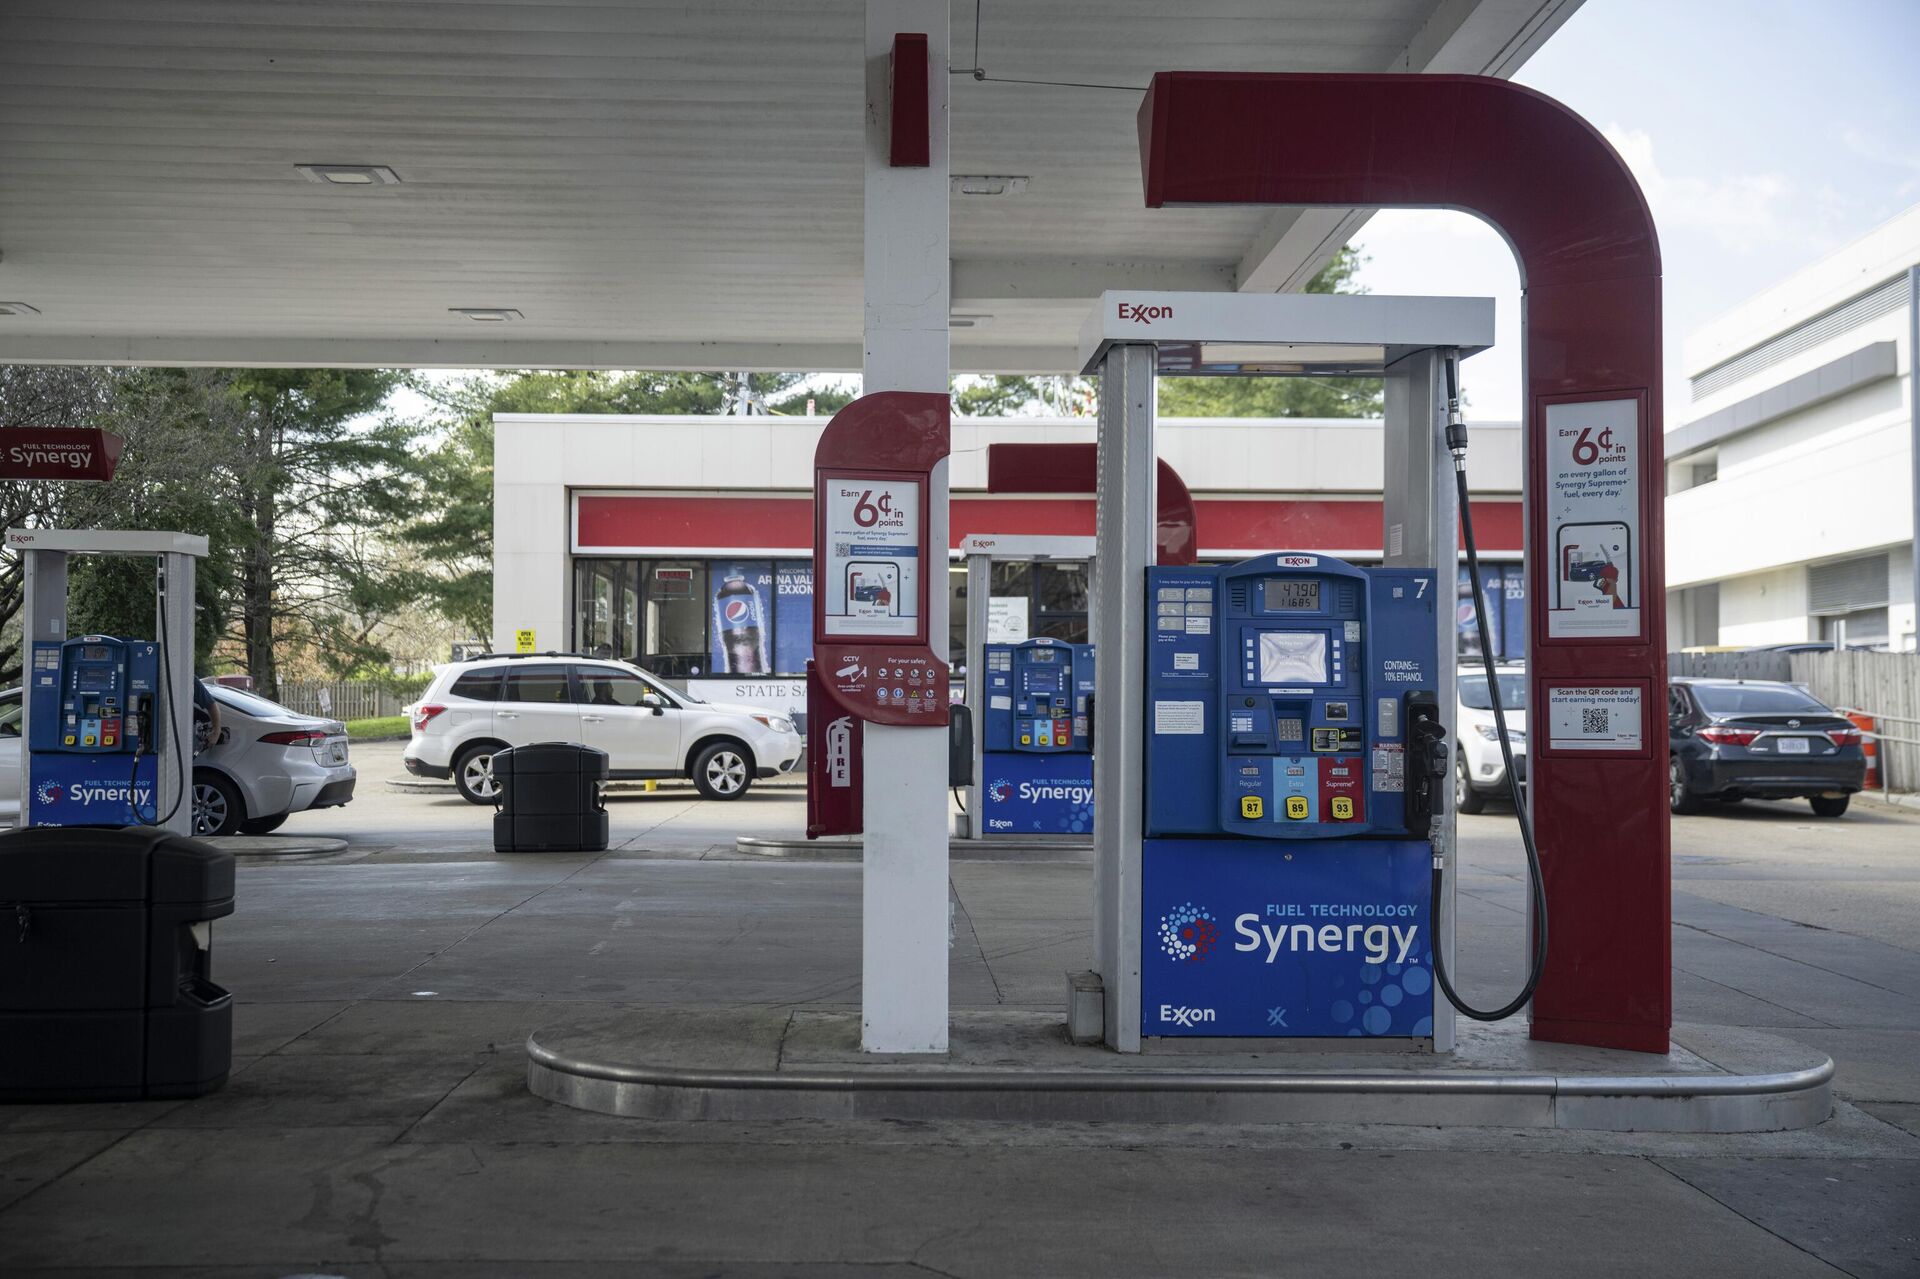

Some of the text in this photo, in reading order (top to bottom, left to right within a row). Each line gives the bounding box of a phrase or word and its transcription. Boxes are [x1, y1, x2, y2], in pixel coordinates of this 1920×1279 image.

[1118, 303, 1172, 324] Exxon
[1559, 426, 1626, 466] Earn 6¢ in
[10, 447, 92, 468] Synergy
[1598, 455, 1626, 465] points
[1570, 471, 1592, 479] every
[1592, 469, 1617, 478] gallon
[1555, 481, 1587, 490] Synergy
[1582, 490, 1603, 498] every
[840, 489, 904, 528] Earn 6¢ in
[878, 519, 904, 528] points
[10, 535, 34, 544] Exxon
[972, 540, 996, 548] Exxon
[1285, 557, 1310, 566] EXXON
[757, 575, 792, 585] ARNA
[778, 585, 814, 594] EXXON
[1258, 583, 1264, 591] $
[1414, 578, 1429, 599] 7
[1188, 590, 1194, 598] 2
[147, 646, 153, 655] 9
[1384, 660, 1412, 670] CONTAINS
[1384, 672, 1423, 682] 10% ETHANOL
[735, 685, 786, 697] STATE
[1617, 696, 1640, 704] today!
[837, 733, 845, 779] FIRE
[1239, 780, 1263, 788] Regular
[70, 784, 151, 806] Synergy
[1019, 782, 1093, 804] Synergy
[1246, 803, 1258, 812] 87
[1292, 803, 1304, 813] 89
[1336, 803, 1349, 813] 93
[989, 819, 1013, 829] Exxon
[1266, 904, 1418, 917] FUEL TECHNOLOGY
[1234, 913, 1418, 964] Synergy
[1160, 1004, 1215, 1027] Exxon
